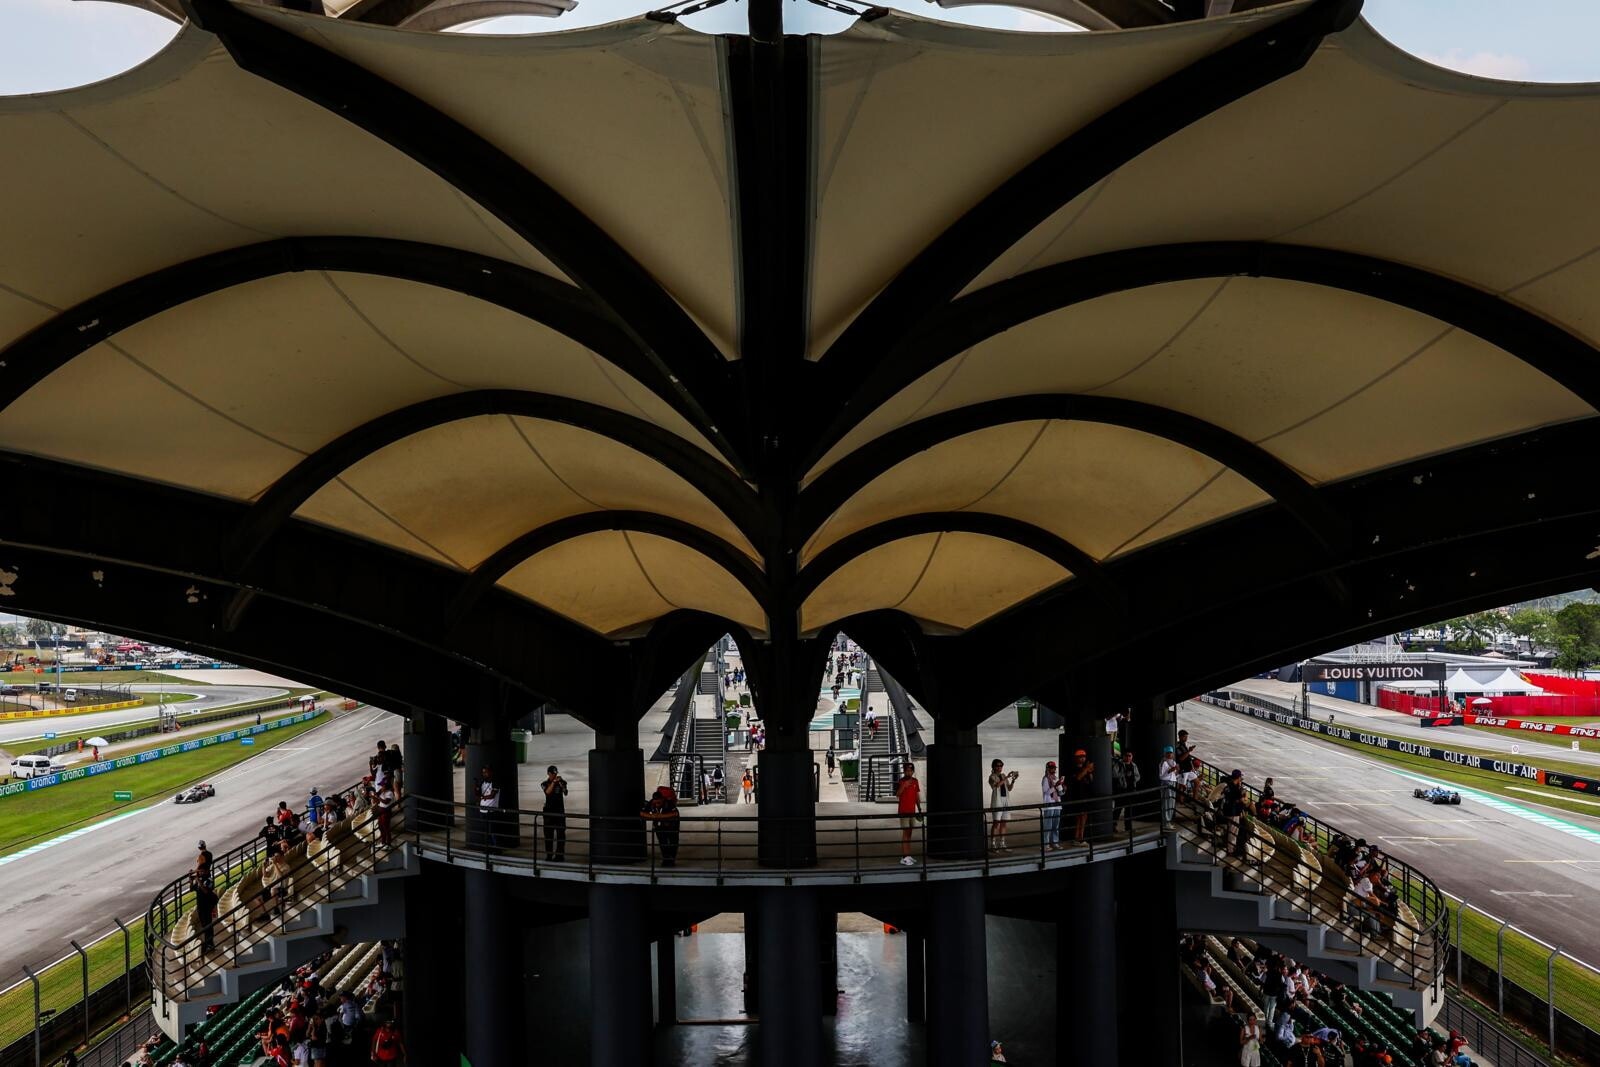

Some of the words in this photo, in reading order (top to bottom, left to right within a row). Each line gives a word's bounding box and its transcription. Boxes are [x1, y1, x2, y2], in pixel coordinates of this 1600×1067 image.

[1324, 668, 1363, 679] LOUIS
[1367, 667, 1424, 678] VUITTON
[1300, 720, 1311, 730] GULF
[1312, 722, 1320, 732] AIR
[1520, 722, 1544, 730] STING
[1570, 728, 1596, 736] STING
[1327, 726, 1340, 736] GULF
[1341, 729, 1350, 740] AIR
[1360, 734, 1376, 745] GULF
[1377, 738, 1388, 748] AIR
[163, 746, 180, 756] aramco
[1399, 741, 1417, 754] GULF
[1418, 746, 1430, 757] AIR
[116, 756, 136, 768] aramco
[141, 750, 158, 762] aramco
[1444, 750, 1464, 764] GULF
[1466, 756, 1480, 768] AIR
[90, 762, 112, 774] aramco
[1494, 760, 1519, 774] GULF
[1520, 766, 1538, 780] AIR
[62, 769, 84, 780] aramco
[32, 776, 56, 788] aramco
